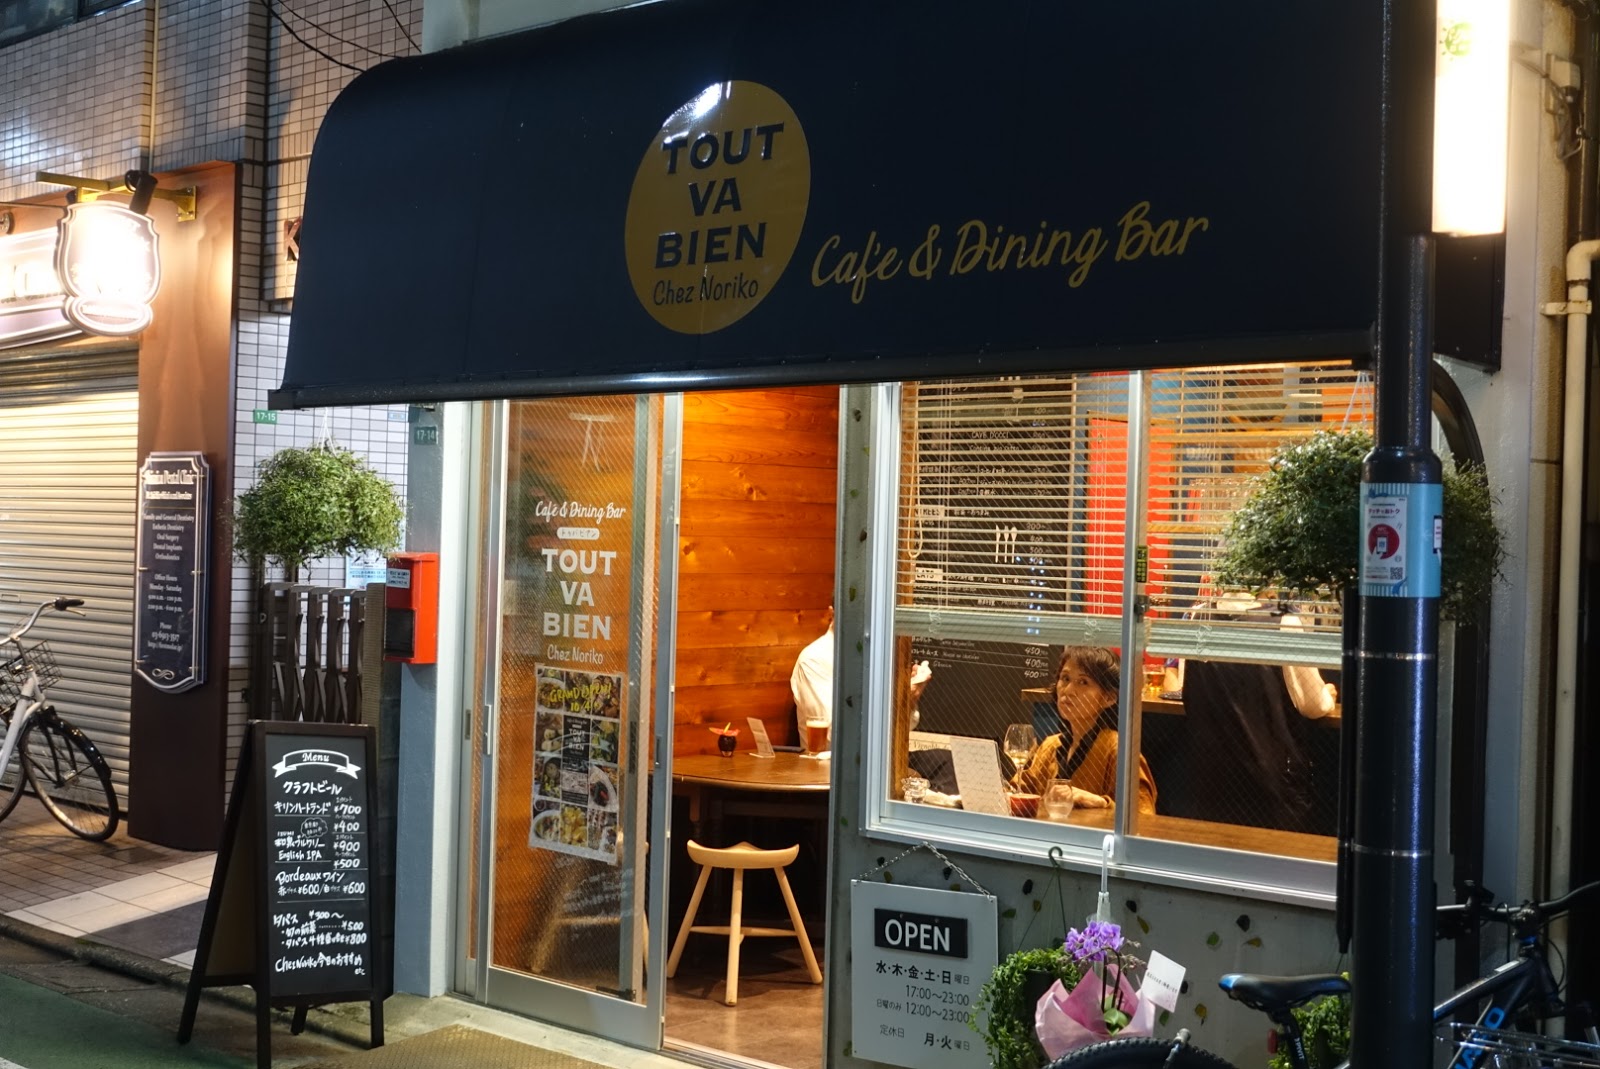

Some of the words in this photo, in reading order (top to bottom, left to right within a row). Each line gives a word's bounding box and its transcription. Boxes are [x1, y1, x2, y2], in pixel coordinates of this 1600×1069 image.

[662, 122, 785, 175] TOUT
[687, 177, 742, 217] VA
[655, 221, 768, 269] BIEN
[908, 224, 942, 280] &
[949, 218, 1110, 289] Dining
[1114, 200, 1210, 262] Bar
[652, 279, 695, 307] Chez
[700, 275, 759, 302] Noriko
[256, 412, 276, 422] 17-15
[535, 500, 558, 523] Café
[559, 501, 568, 519] &
[569, 501, 605, 524] Dining
[606, 502, 626, 519] Bar
[541, 547, 617, 576] TOUT
[560, 580, 595, 607] VA
[542, 611, 612, 641] BIEN
[547, 644, 570, 661] Chez
[572, 646, 604, 664] Noriko
[302, 752, 330, 762] Menu
[283, 780, 343, 795] クラフトビール
[274, 801, 331, 814] キリンハートランド
[333, 803, 362, 815] ¥700
[333, 820, 360, 833] ¥400
[332, 840, 361, 852] ¥900
[333, 858, 361, 870] ¥500
[884, 918, 950, 952] OPEN
[876, 998, 902, 1012] 日曜のみ
[879, 1024, 905, 1038] 定休日
